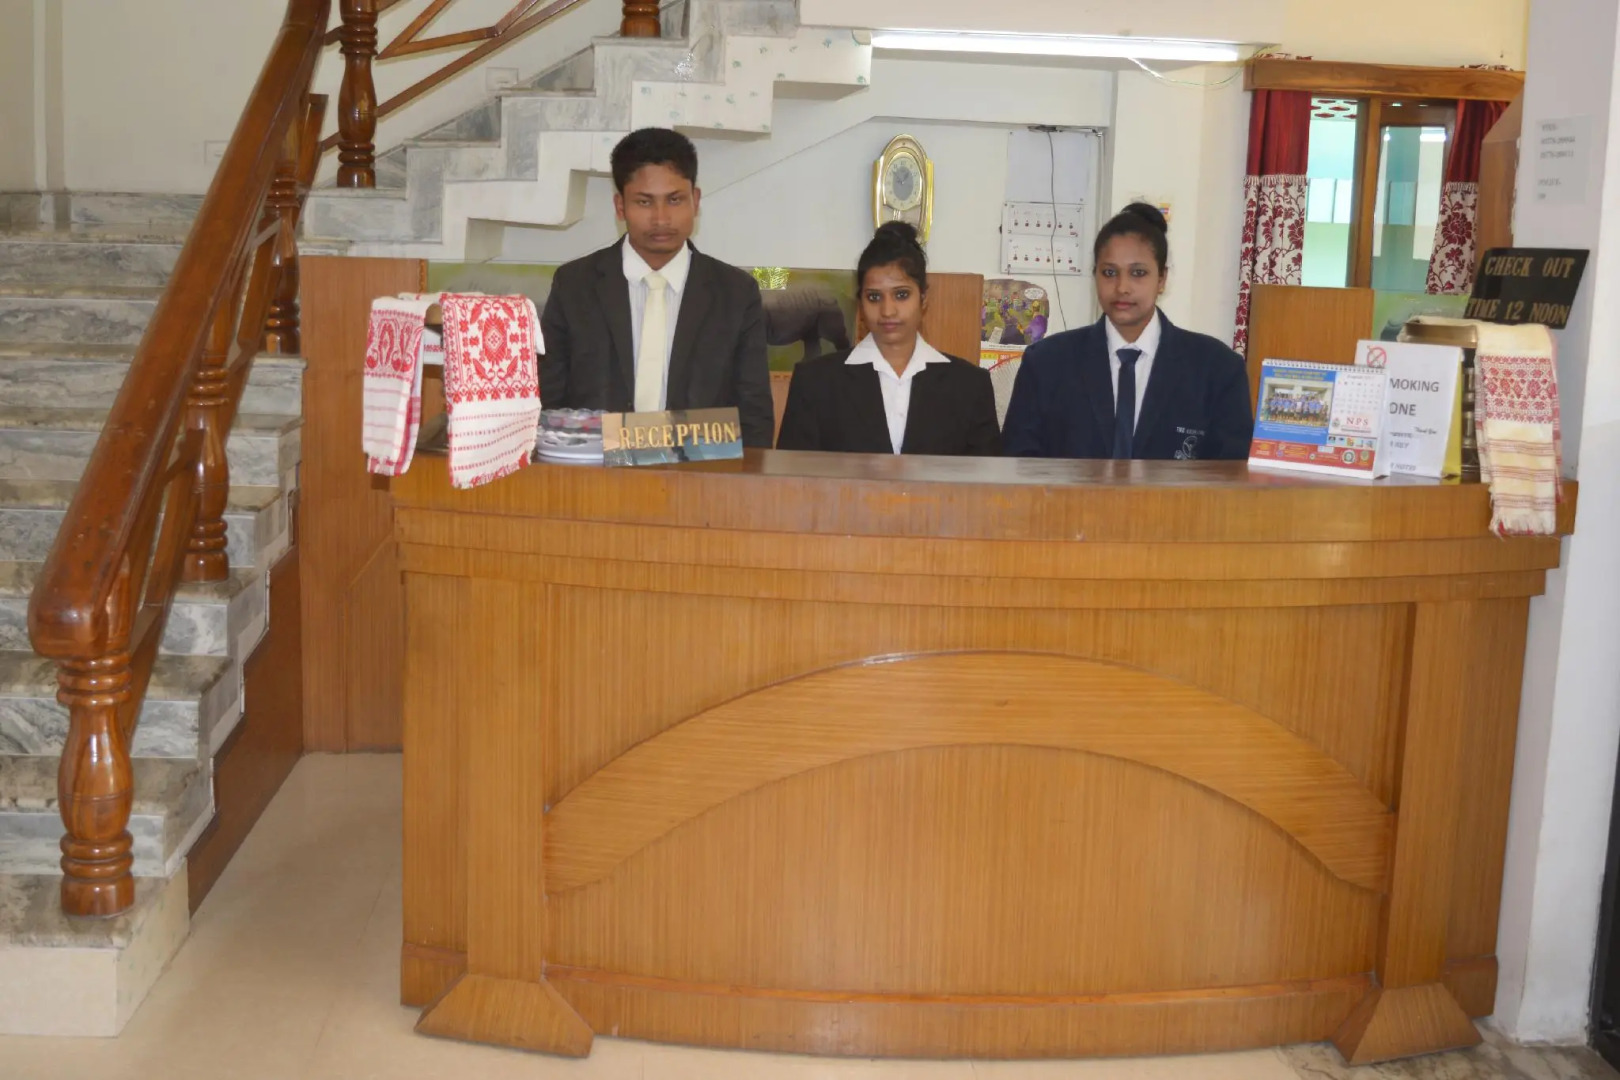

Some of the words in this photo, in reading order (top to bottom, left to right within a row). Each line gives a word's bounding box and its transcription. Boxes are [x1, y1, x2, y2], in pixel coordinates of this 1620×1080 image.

[1484, 256, 1533, 277] CHECK
[1542, 257, 1575, 278] OUT
[1466, 298, 1500, 319] TIME
[1504, 300, 1524, 320] 12
[1528, 302, 1569, 324] NOON
[1389, 378, 1439, 393] MOKING
[1389, 402, 1416, 416] ONE
[618, 421, 738, 450] RECEPTION
